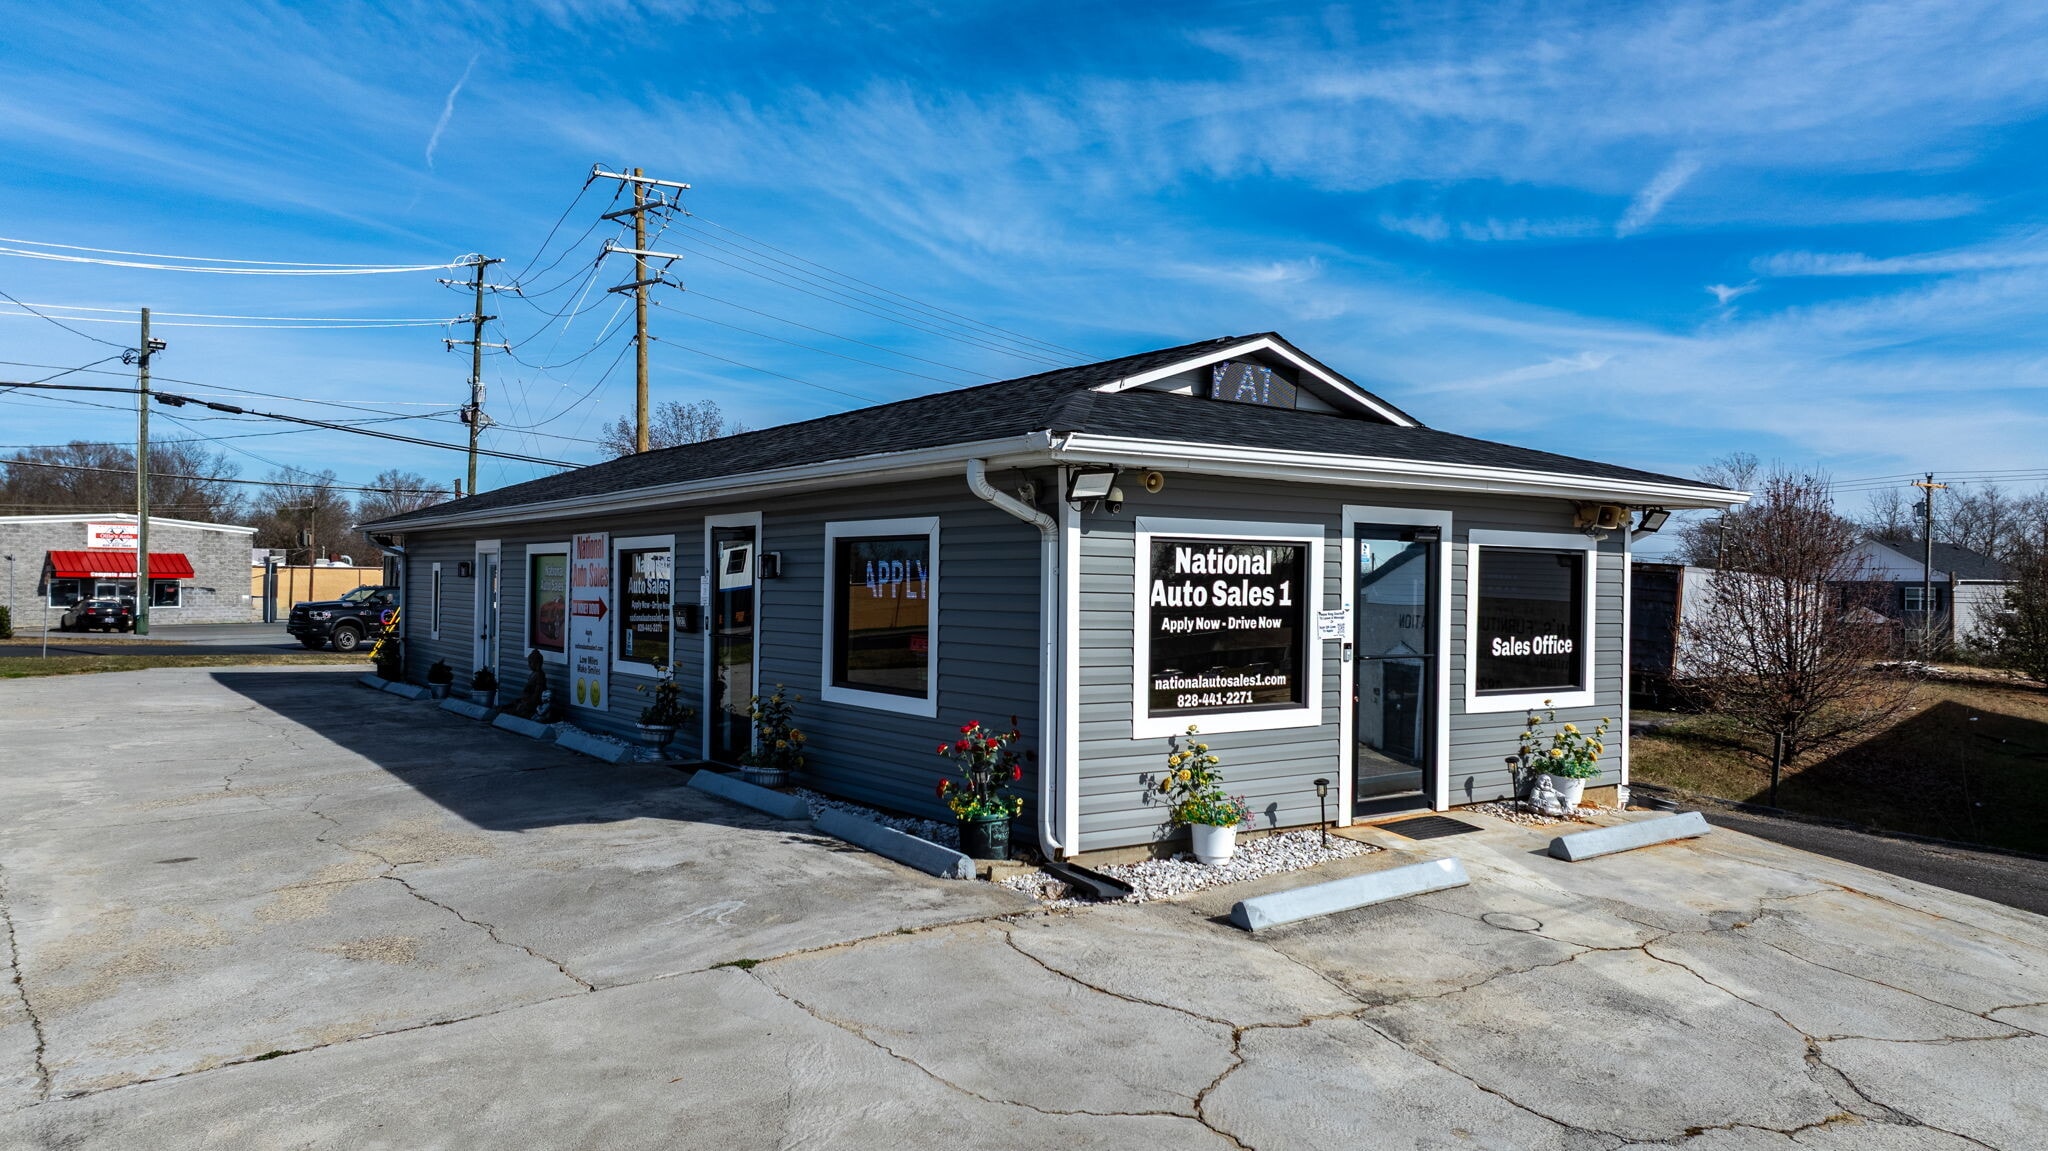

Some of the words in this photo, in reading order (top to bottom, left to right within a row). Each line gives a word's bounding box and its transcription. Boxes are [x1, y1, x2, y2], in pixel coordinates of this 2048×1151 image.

[1235, 364, 1272, 402] AT
[577, 535, 604, 559] National
[1175, 547, 1272, 575] National
[572, 563, 587, 588] Auto
[589, 562, 609, 588] Sales
[866, 559, 927, 599] APPLY
[628, 577, 646, 594] Auto
[647, 578, 669, 595] Sales
[1151, 579, 1207, 607] Auto
[1212, 579, 1275, 607] Sales
[1279, 580, 1292, 606] 1
[631, 600, 641, 611] Apply
[1161, 617, 1194, 633] Apply
[1196, 616, 1220, 630] Now
[1228, 616, 1257, 630] Drive
[1258, 616, 1282, 629] Now
[1491, 636, 1531, 656] Sales
[1532, 635, 1573, 655] Office
[577, 664, 587, 673] Make
[588, 665, 601, 675] Smiles
[579, 655, 587, 664] Low
[587, 656, 598, 666] Miles
[1155, 673, 1286, 690] nationalautosales1.com
[1177, 691, 1253, 708] 828-441-2271
